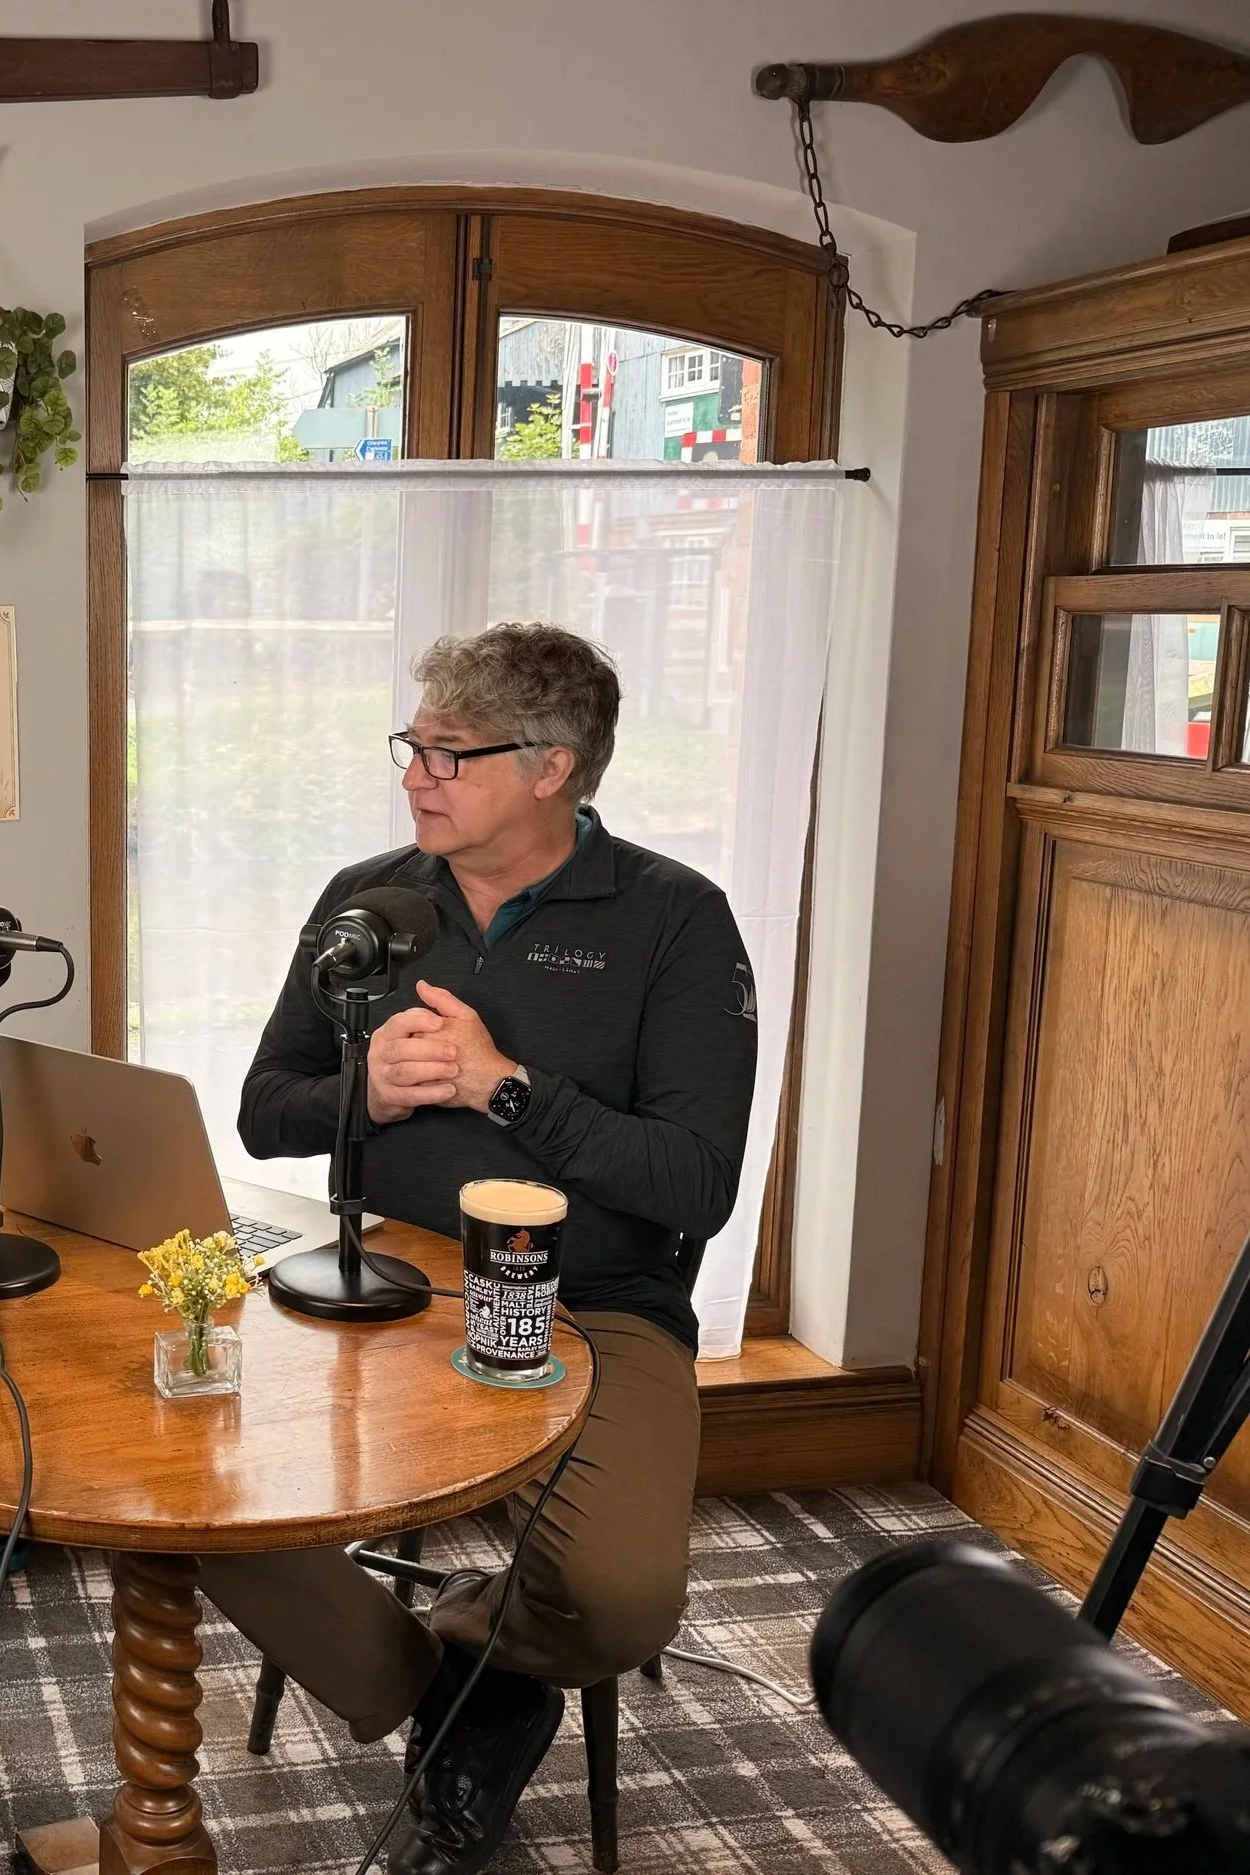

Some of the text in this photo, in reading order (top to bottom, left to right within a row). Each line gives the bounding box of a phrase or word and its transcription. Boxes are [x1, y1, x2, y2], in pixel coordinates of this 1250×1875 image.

[534, 943, 607, 960] TRILOGY
[490, 1251, 549, 1263] ROBINSONS
[500, 1265, 539, 1280] BREWERY
[468, 1273, 493, 1290] CASK
[469, 1282, 493, 1296] BARLEY
[535, 1275, 559, 1292] FREDE
[501, 1290, 527, 1300] 1838
[526, 1285, 535, 1309] TASTE
[493, 1282, 501, 1328] AUTHENTIC
[501, 1300, 526, 1309] MALT
[501, 1306, 547, 1317] HISTORY
[499, 1315, 507, 1336] OVER
[507, 1315, 546, 1336] 185
[467, 1330, 497, 1349] OPNIK
[499, 1334, 543, 1347] YEARS
[476, 1343, 535, 1359] PROVENANCE
